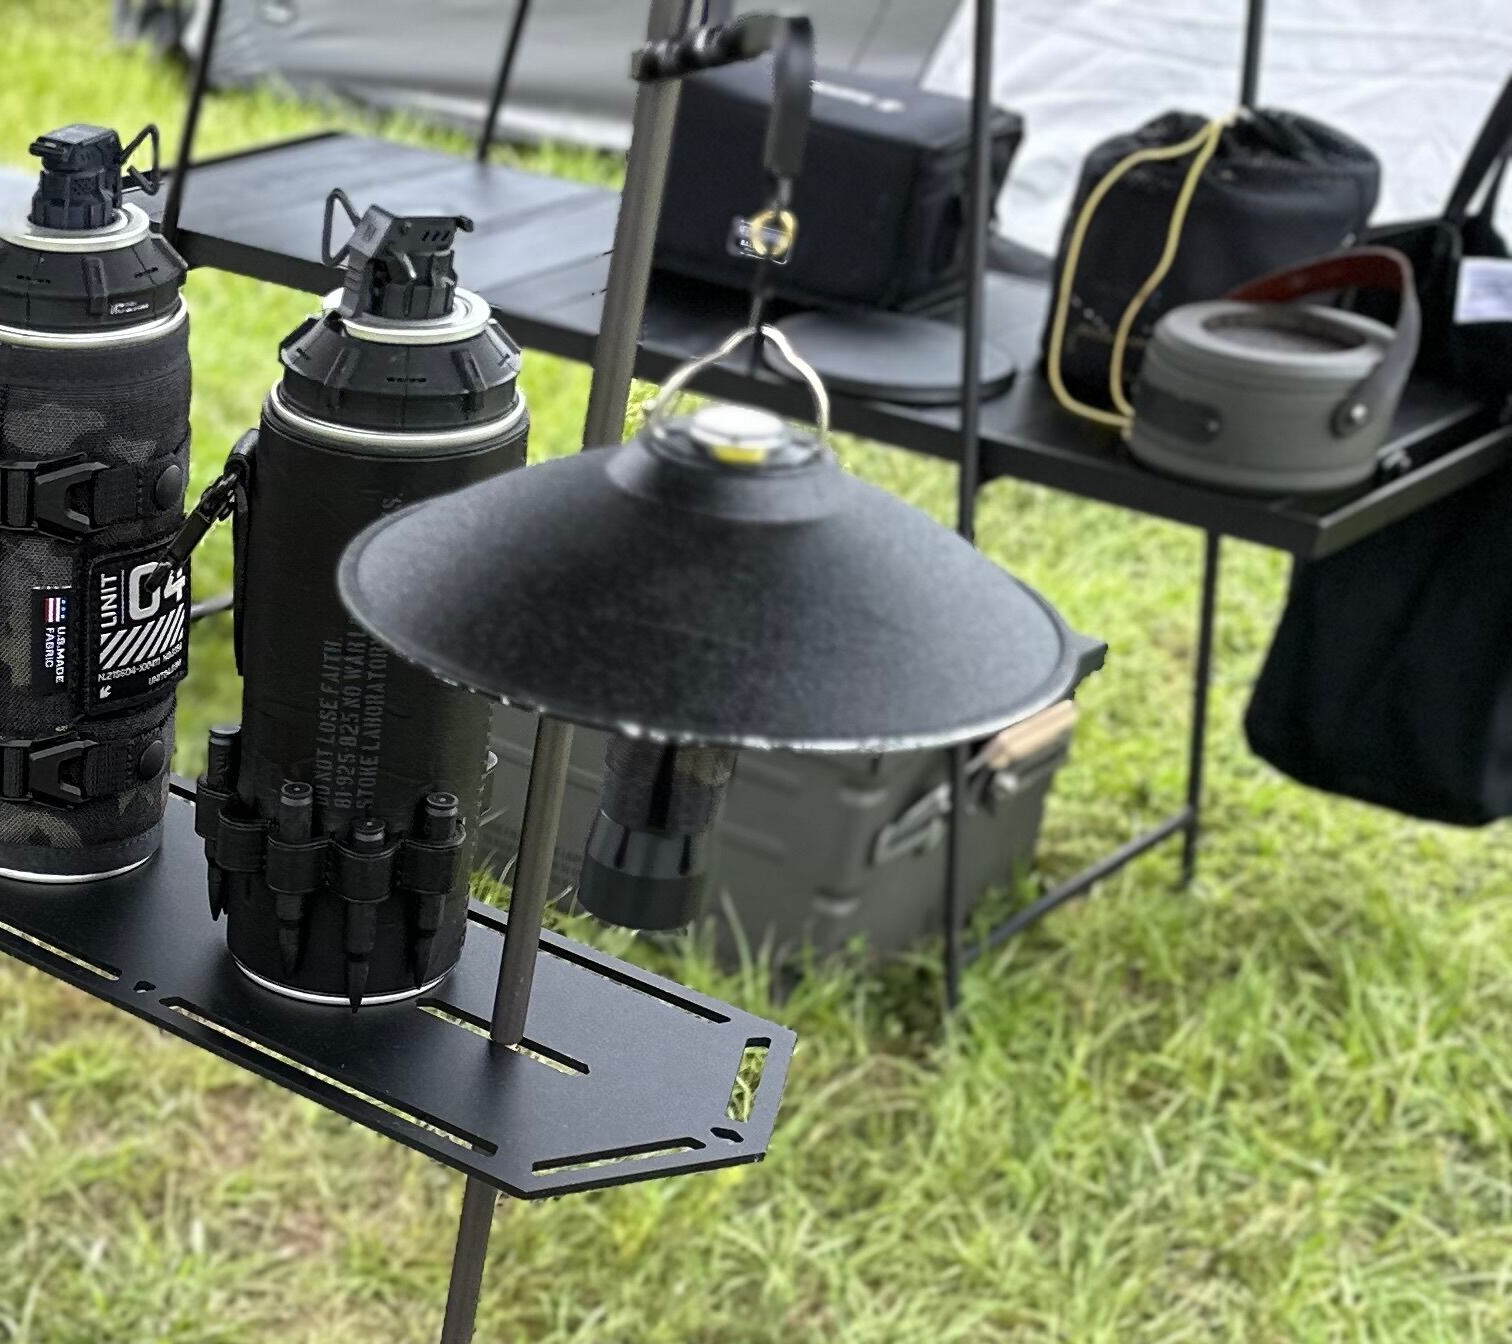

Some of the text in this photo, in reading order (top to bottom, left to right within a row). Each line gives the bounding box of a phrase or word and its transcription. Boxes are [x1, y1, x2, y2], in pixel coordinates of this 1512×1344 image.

[101, 573, 118, 628] UNIT
[45, 627, 54, 668] FABRIC
[316, 697, 338, 743] LOSE
